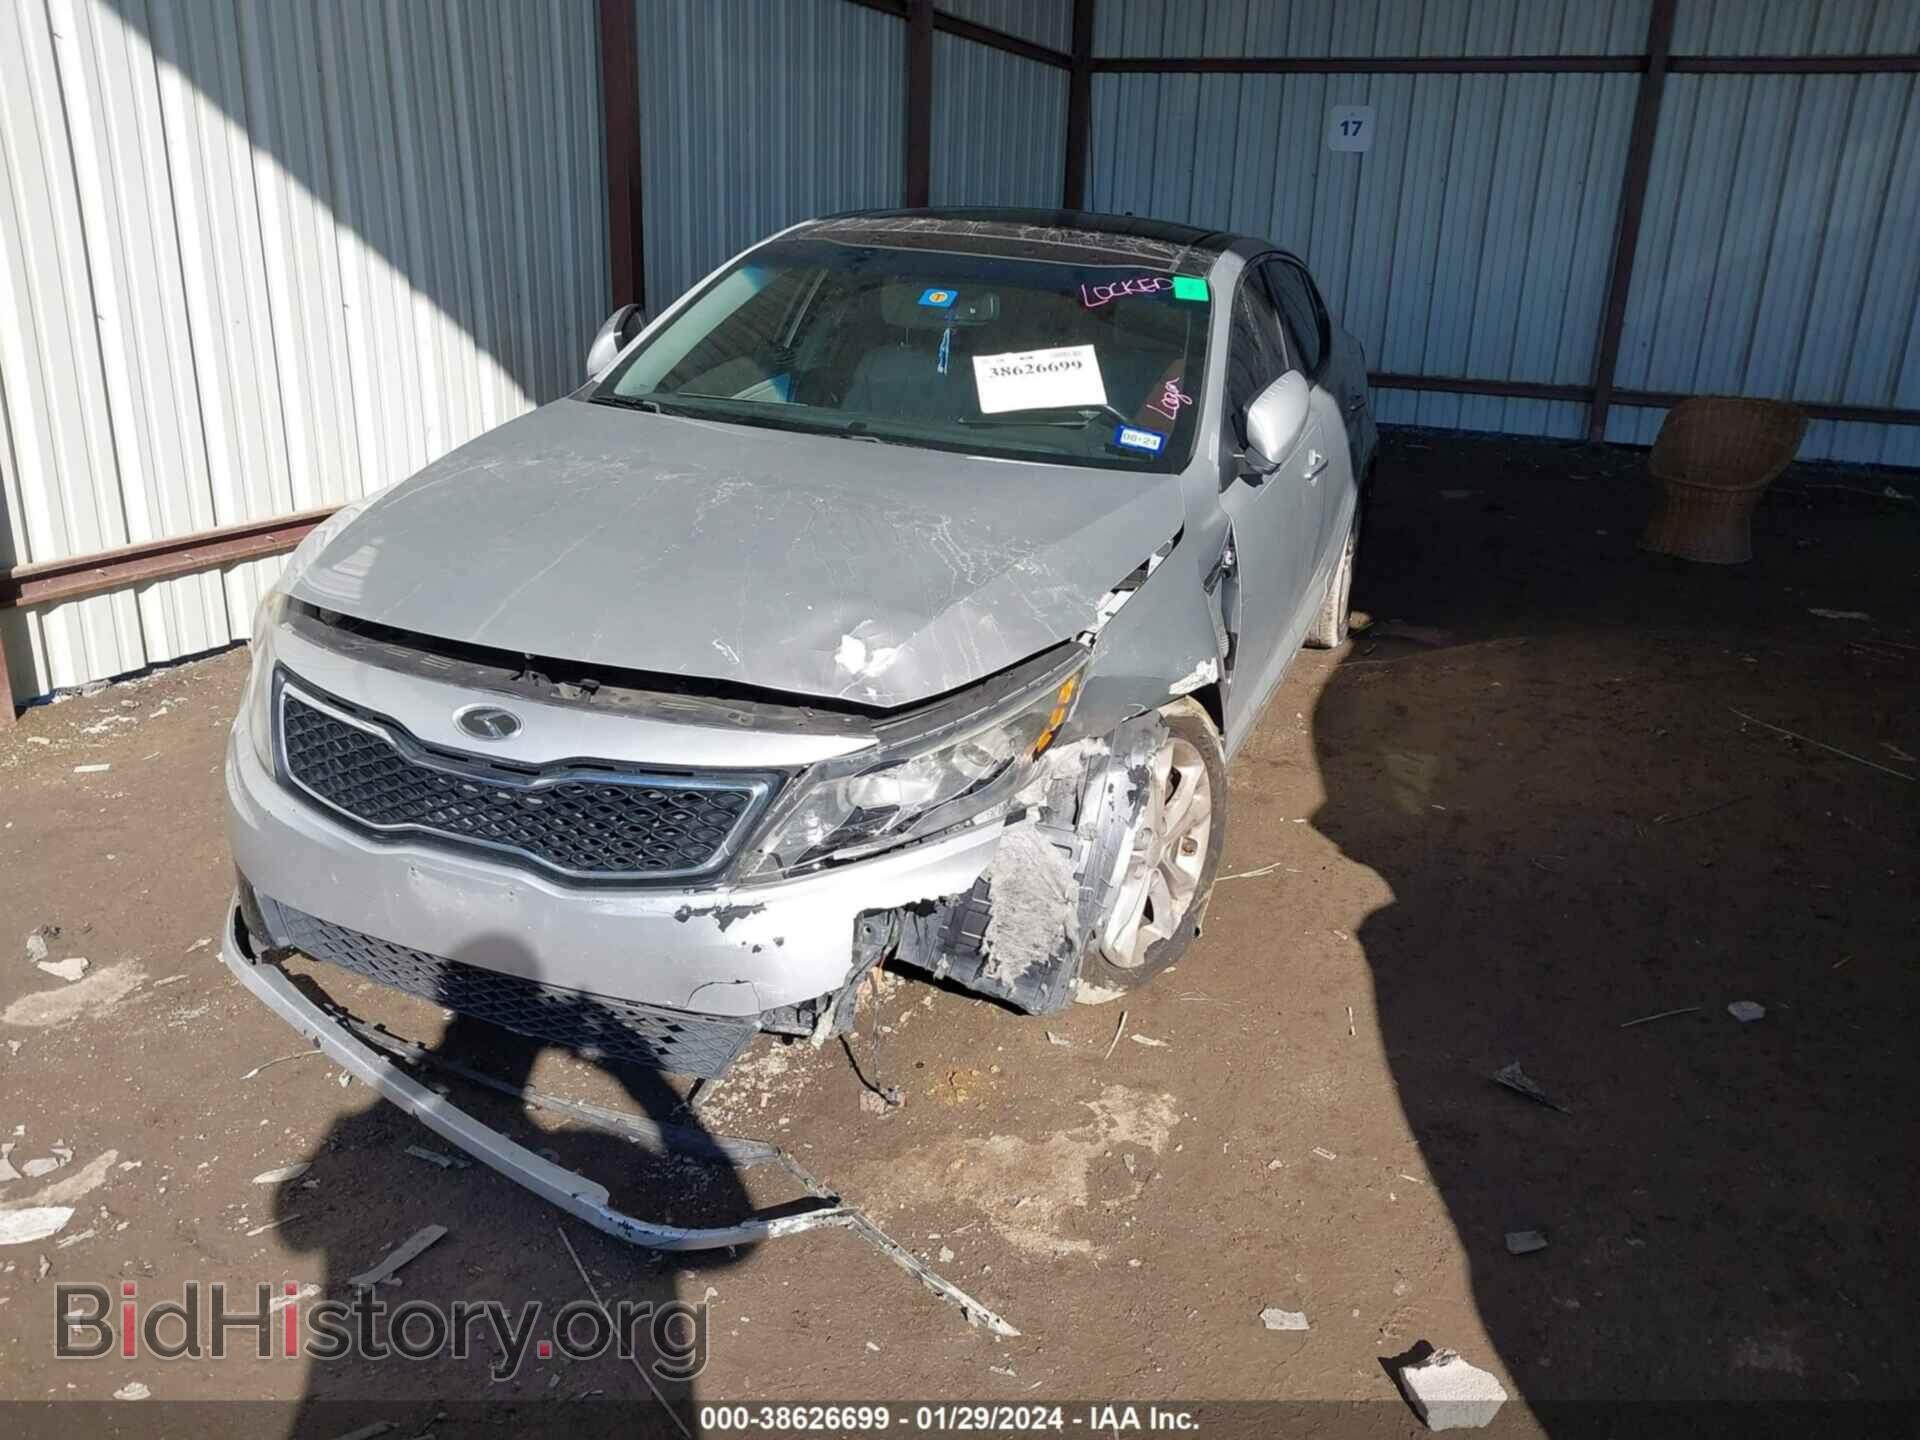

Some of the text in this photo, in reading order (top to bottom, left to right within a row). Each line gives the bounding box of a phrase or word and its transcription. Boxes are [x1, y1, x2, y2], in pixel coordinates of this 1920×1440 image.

[1340, 120, 1363, 137] 17
[1081, 277, 1175, 307] LOCKED
[988, 360, 1083, 379] 38626699
